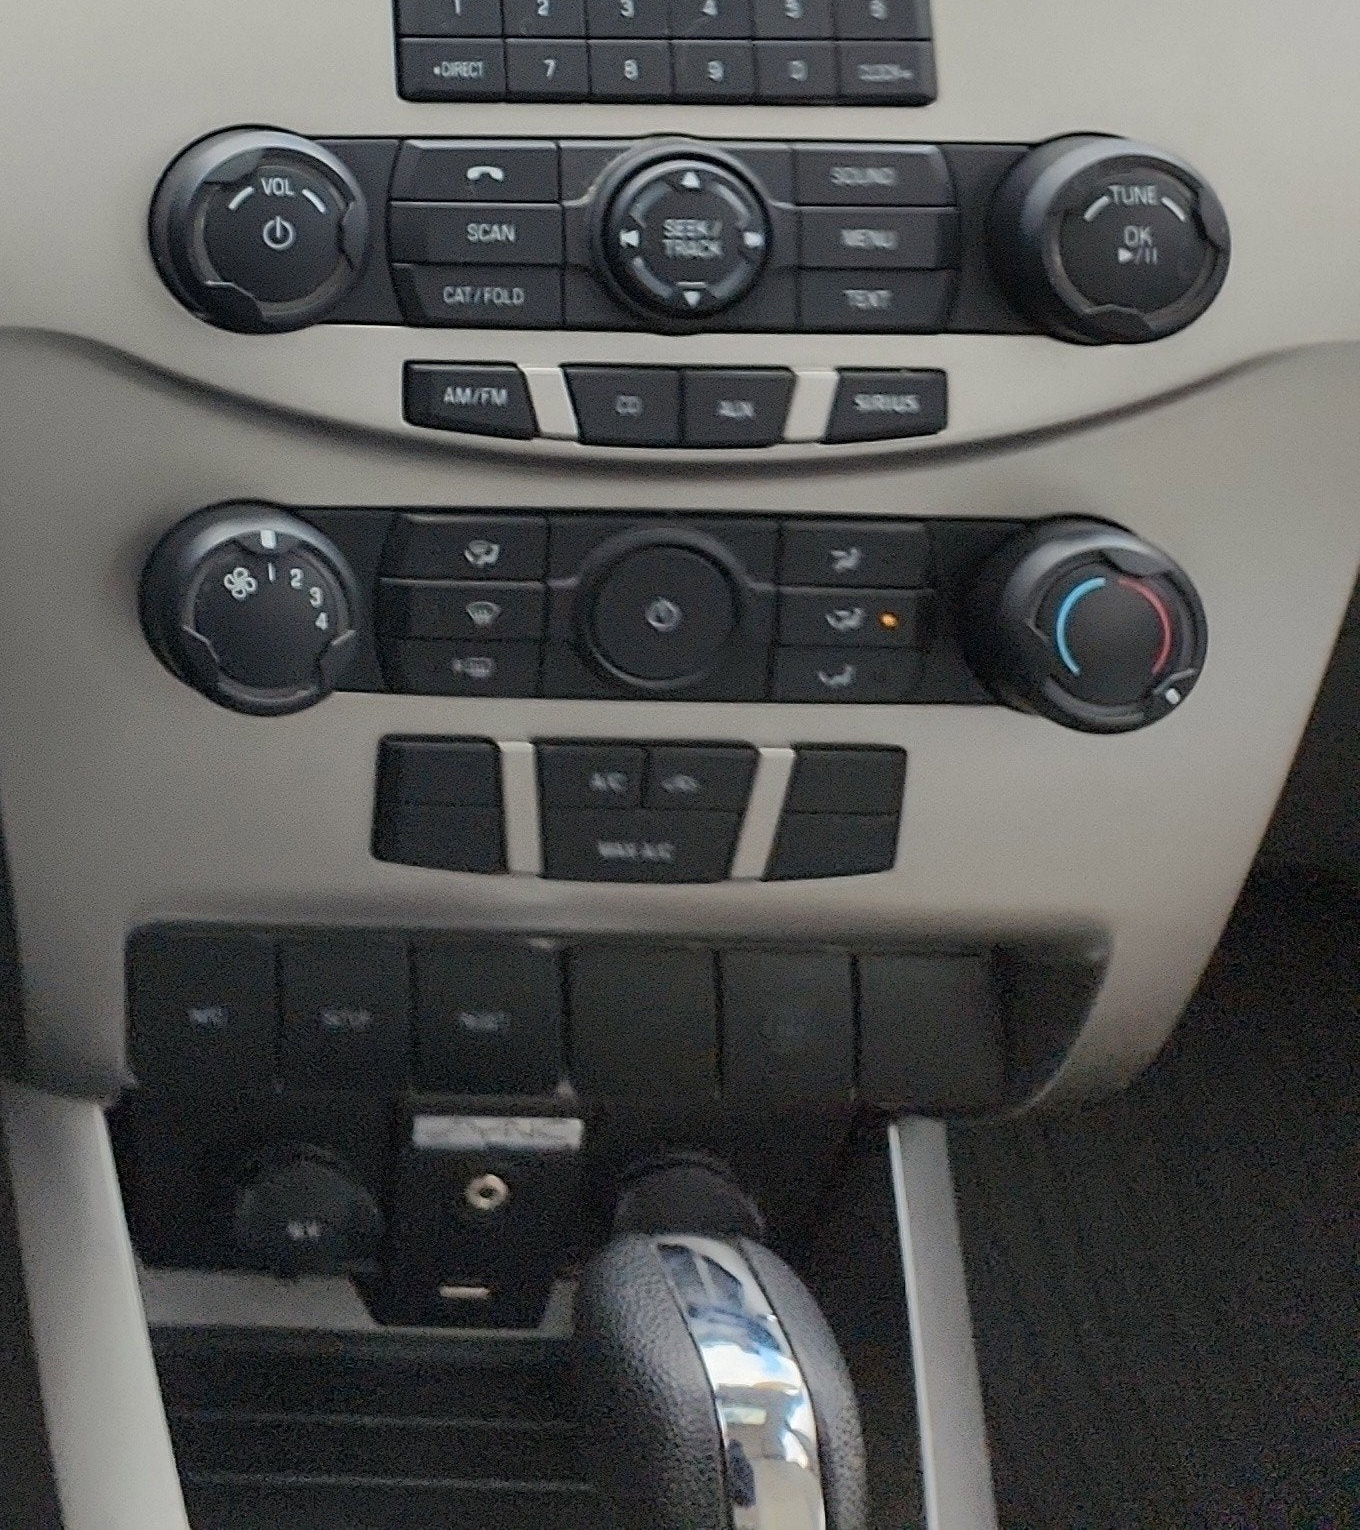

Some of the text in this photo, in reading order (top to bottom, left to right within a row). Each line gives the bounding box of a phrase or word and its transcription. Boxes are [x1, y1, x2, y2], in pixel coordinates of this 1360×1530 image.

[543, 59, 556, 78] 7
[624, 59, 639, 81] 8
[261, 178, 294, 197] VOL
[1109, 185, 1158, 205] TUNE
[466, 224, 516, 243] SCAN
[1123, 225, 1153, 247] OK
[442, 286, 525, 306] CAT/FOLD
[443, 385, 508, 407] AM/FM
[267, 562, 276, 583] 1
[290, 568, 303, 589] 2
[309, 586, 323, 608] 3
[315, 611, 328, 630] 4
